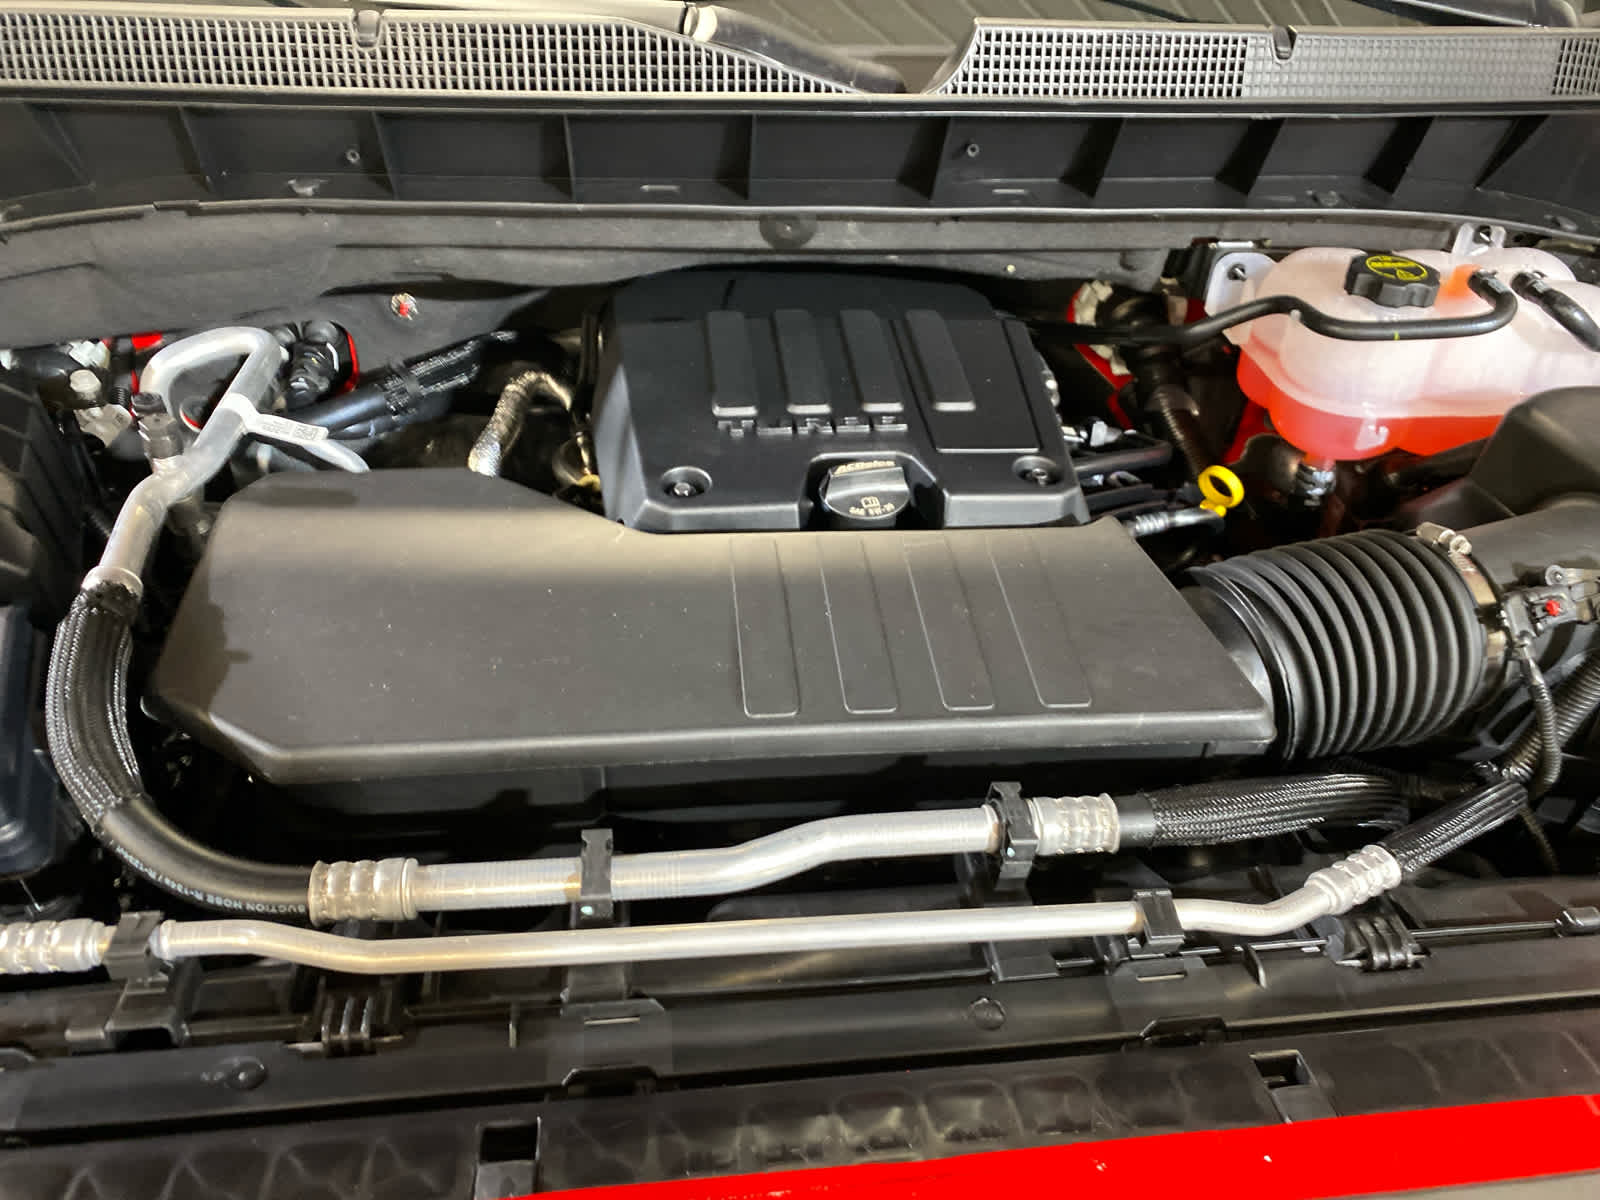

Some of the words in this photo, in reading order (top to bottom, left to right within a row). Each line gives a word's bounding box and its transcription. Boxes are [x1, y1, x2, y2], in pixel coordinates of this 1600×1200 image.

[833, 460, 896, 475] ACDelco
[206, 894, 242, 910] HOSE
[246, 903, 306, 913] SUCTION
